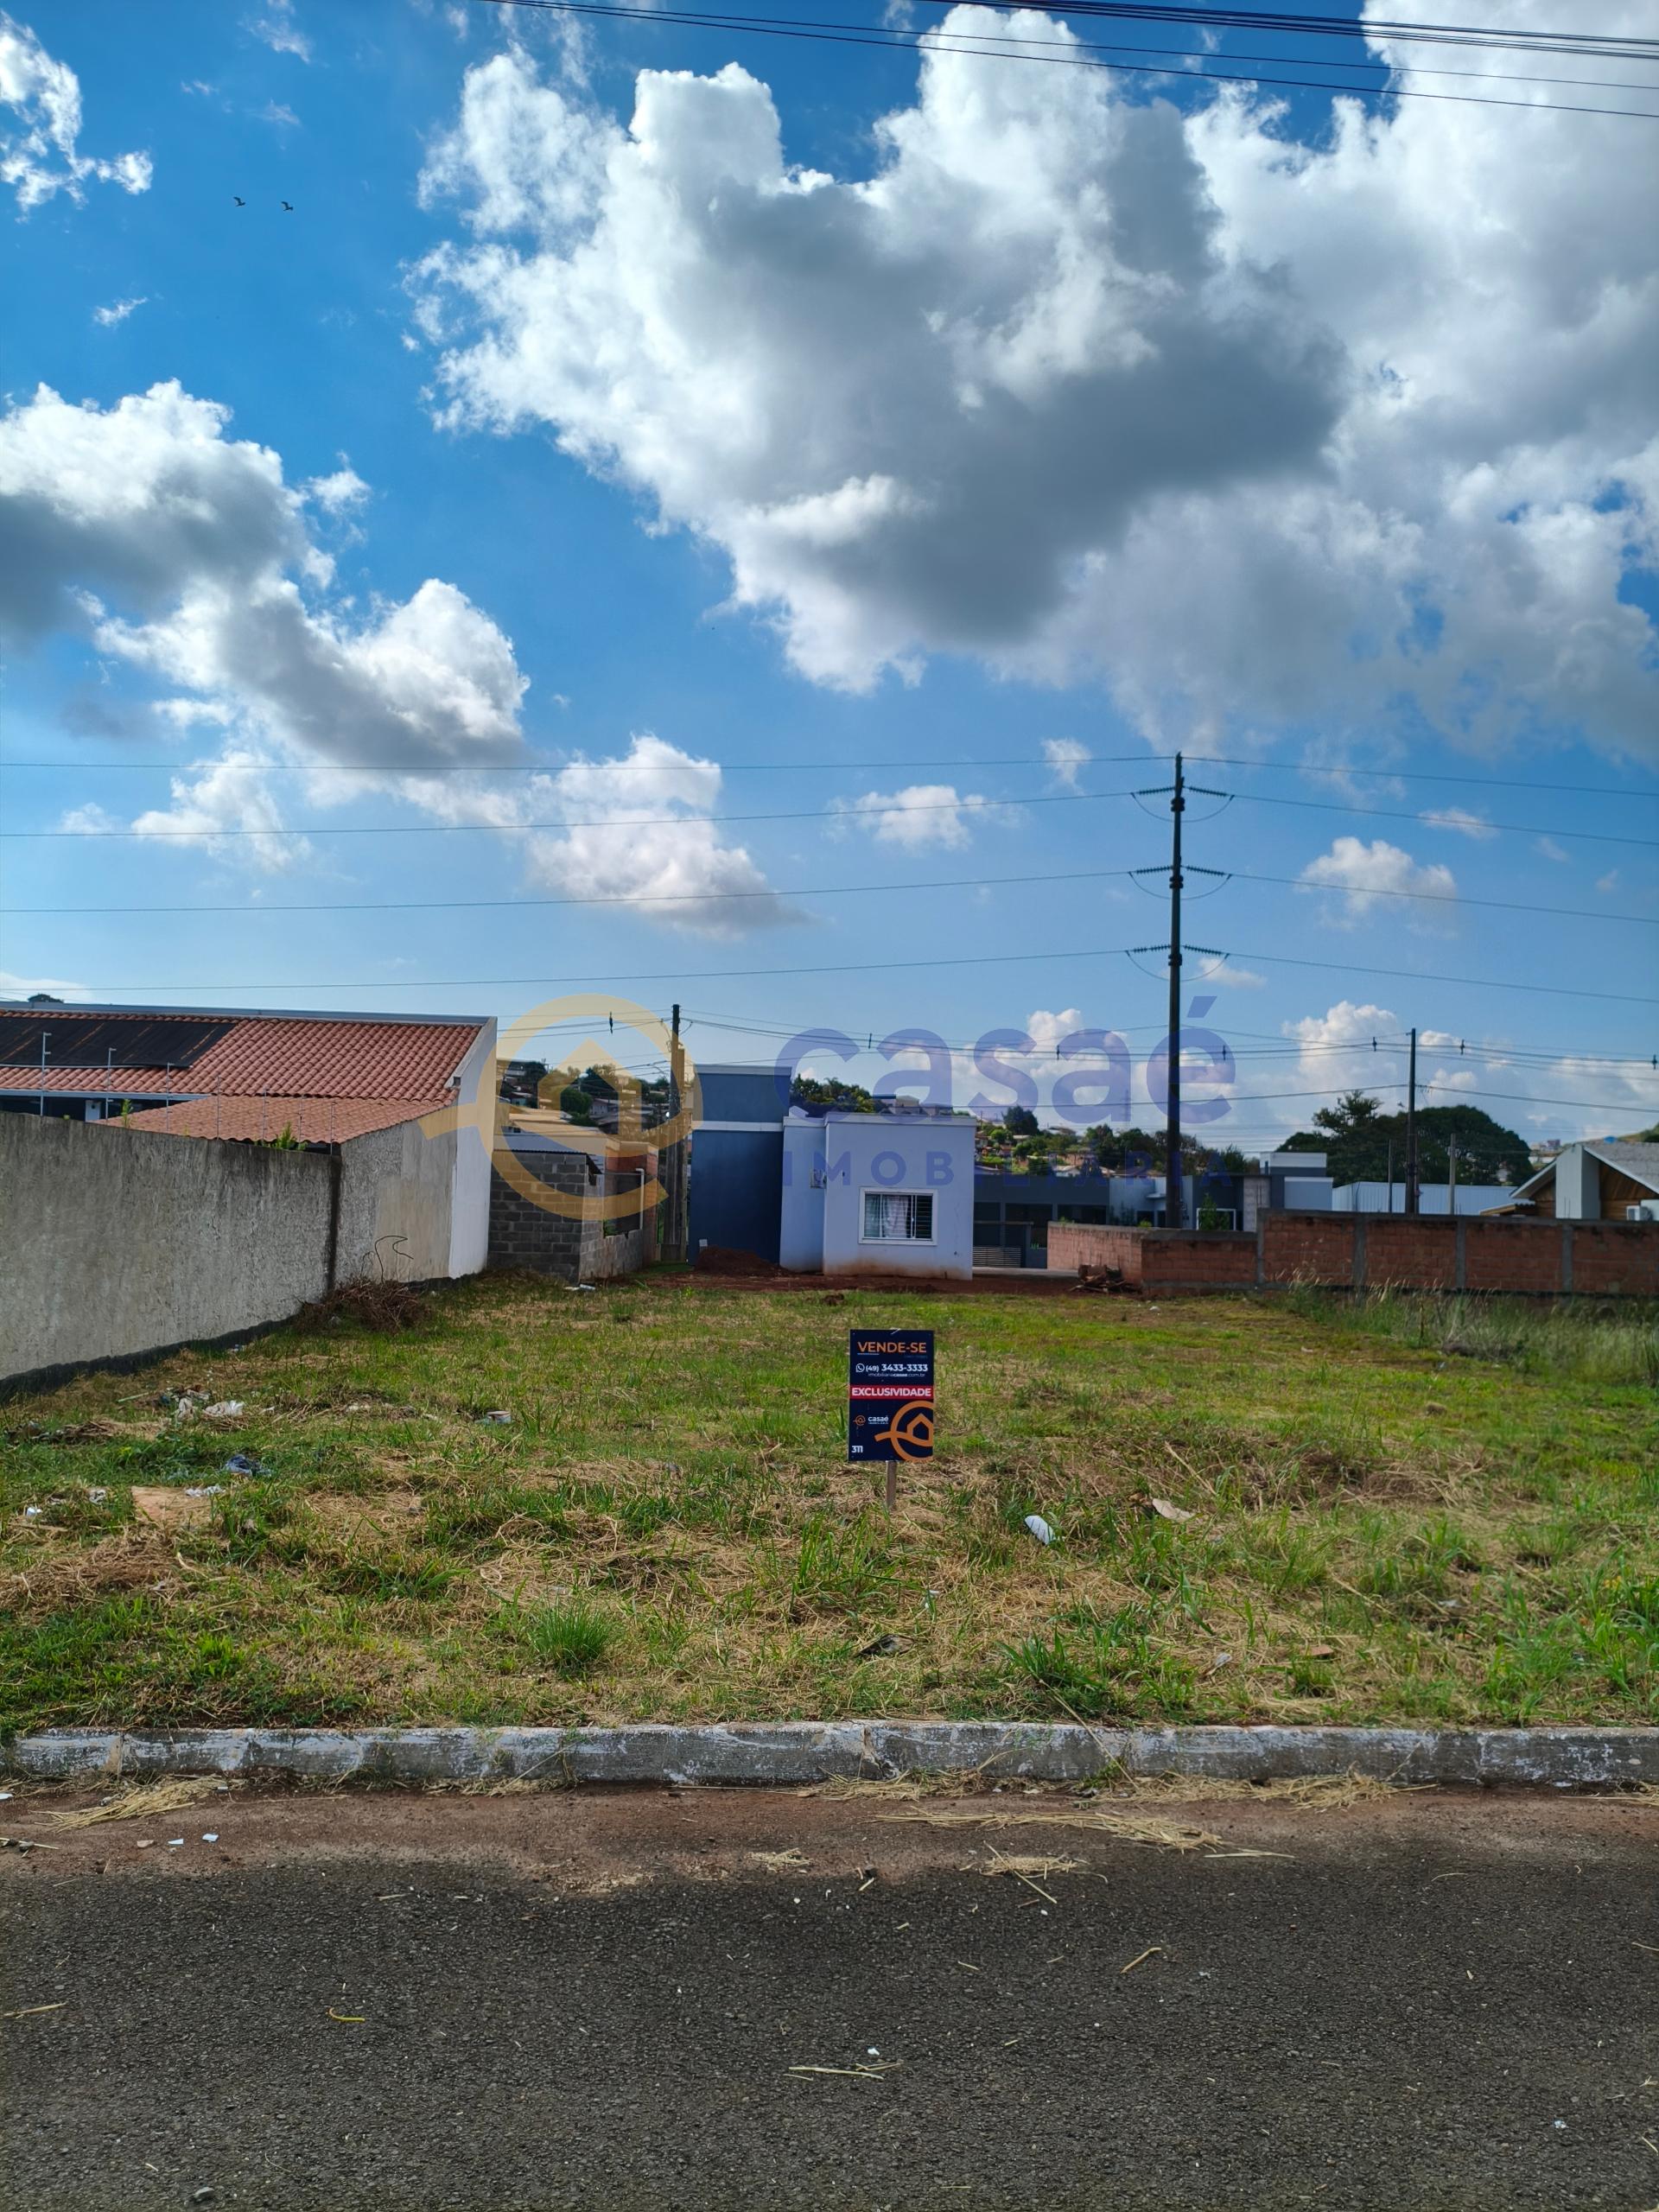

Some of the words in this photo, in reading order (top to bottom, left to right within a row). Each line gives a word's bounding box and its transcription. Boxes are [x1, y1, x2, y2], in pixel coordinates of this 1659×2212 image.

[857, 1342, 927, 1353] VENDE-SE
[851, 1387, 931, 1396] EXCLUSIVIDADE
[851, 1445, 863, 1453] 311
